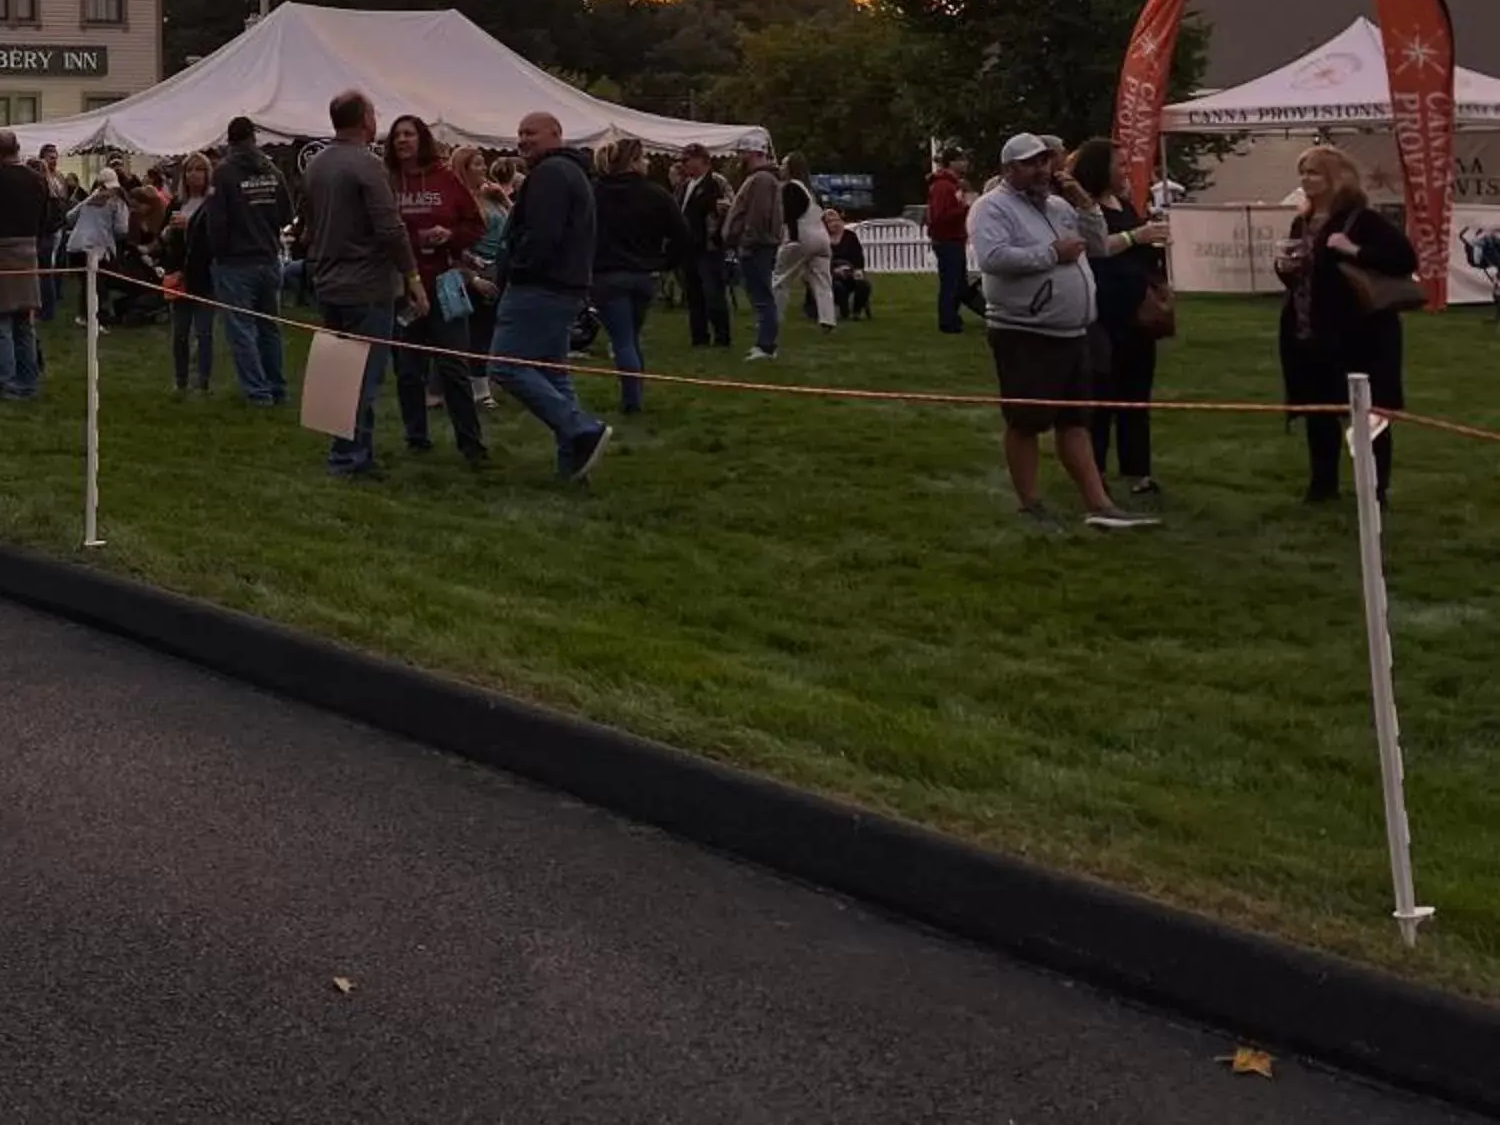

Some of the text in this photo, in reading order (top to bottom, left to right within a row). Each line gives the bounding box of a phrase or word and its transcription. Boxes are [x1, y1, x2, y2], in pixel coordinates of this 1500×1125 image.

[63, 52, 99, 70] INN
[1131, 82, 1157, 163] CANNA
[1188, 102, 1387, 124] CANNA PROVISIONS
[1425, 91, 1451, 188] CANNA
[1394, 91, 1443, 280] PROVISIONS
